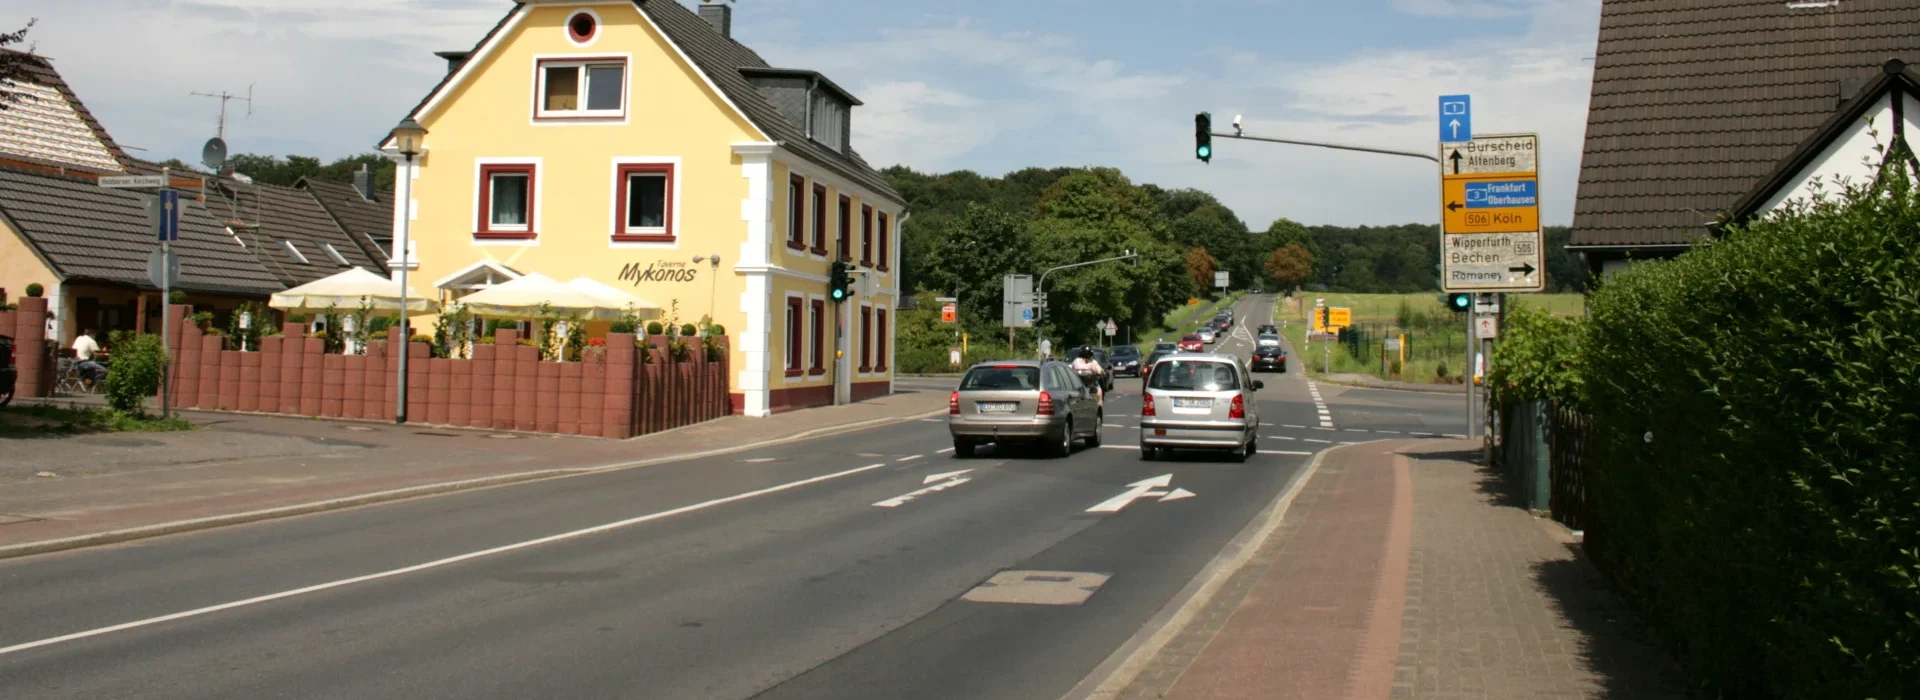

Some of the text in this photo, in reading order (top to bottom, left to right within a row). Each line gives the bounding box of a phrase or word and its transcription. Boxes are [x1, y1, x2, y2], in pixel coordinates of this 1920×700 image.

[1467, 140, 1533, 152] Burscheid
[1468, 156, 1516, 168] Altenberg
[1487, 183, 1526, 193] Frankfurt
[1473, 191, 1480, 199] 3
[1487, 195, 1535, 205] Oberhausen
[1468, 213, 1522, 224] 506 Köln
[1452, 236, 1511, 249] Wipperfürth
[1516, 243, 1532, 253] 506
[1452, 252, 1500, 263] Bechen
[657, 260, 687, 268] Taverne
[618, 262, 697, 287] Mykonos
[1452, 270, 1502, 281] Romaney
